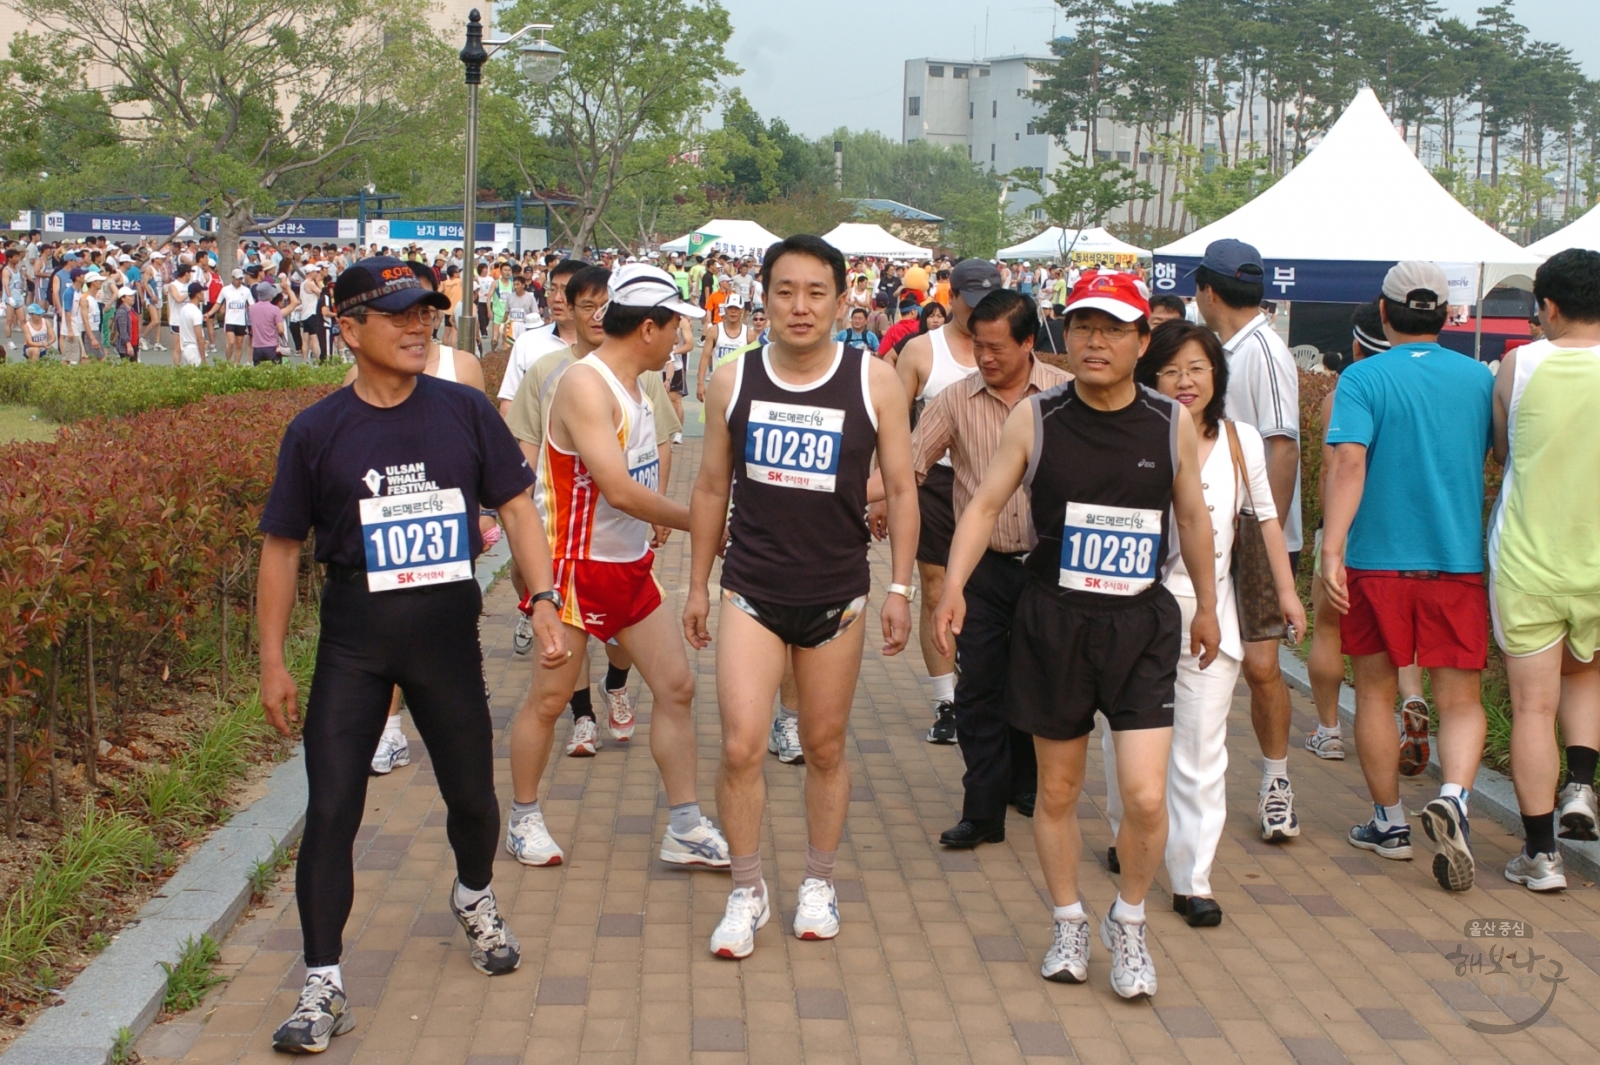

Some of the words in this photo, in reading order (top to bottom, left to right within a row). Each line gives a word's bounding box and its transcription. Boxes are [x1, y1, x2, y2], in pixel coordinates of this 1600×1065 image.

[47, 216, 64, 228] 하프
[91, 218, 142, 231] 물품보관소
[257, 222, 306, 235] 보관소
[416, 224, 436, 237] 남자
[1154, 262, 1177, 290] 행
[1272, 266, 1296, 294] 부
[768, 410, 824, 427] 월드메르디앙
[752, 426, 834, 471] 10239
[385, 462, 425, 476] ULSAN
[386, 472, 426, 486] WHALE
[767, 471, 783, 482] SK
[784, 474, 810, 486] 주식회사
[387, 480, 440, 496] FESTIVAL
[381, 493, 444, 518] 월드메르디앙
[1085, 511, 1145, 529] 월드메르디앙
[370, 518, 460, 567] 10237
[1069, 531, 1153, 575] 10238
[397, 572, 416, 584] SK
[416, 570, 445, 582] 주식회사
[1084, 577, 1102, 589] SK
[1102, 581, 1130, 591] 주식회사
